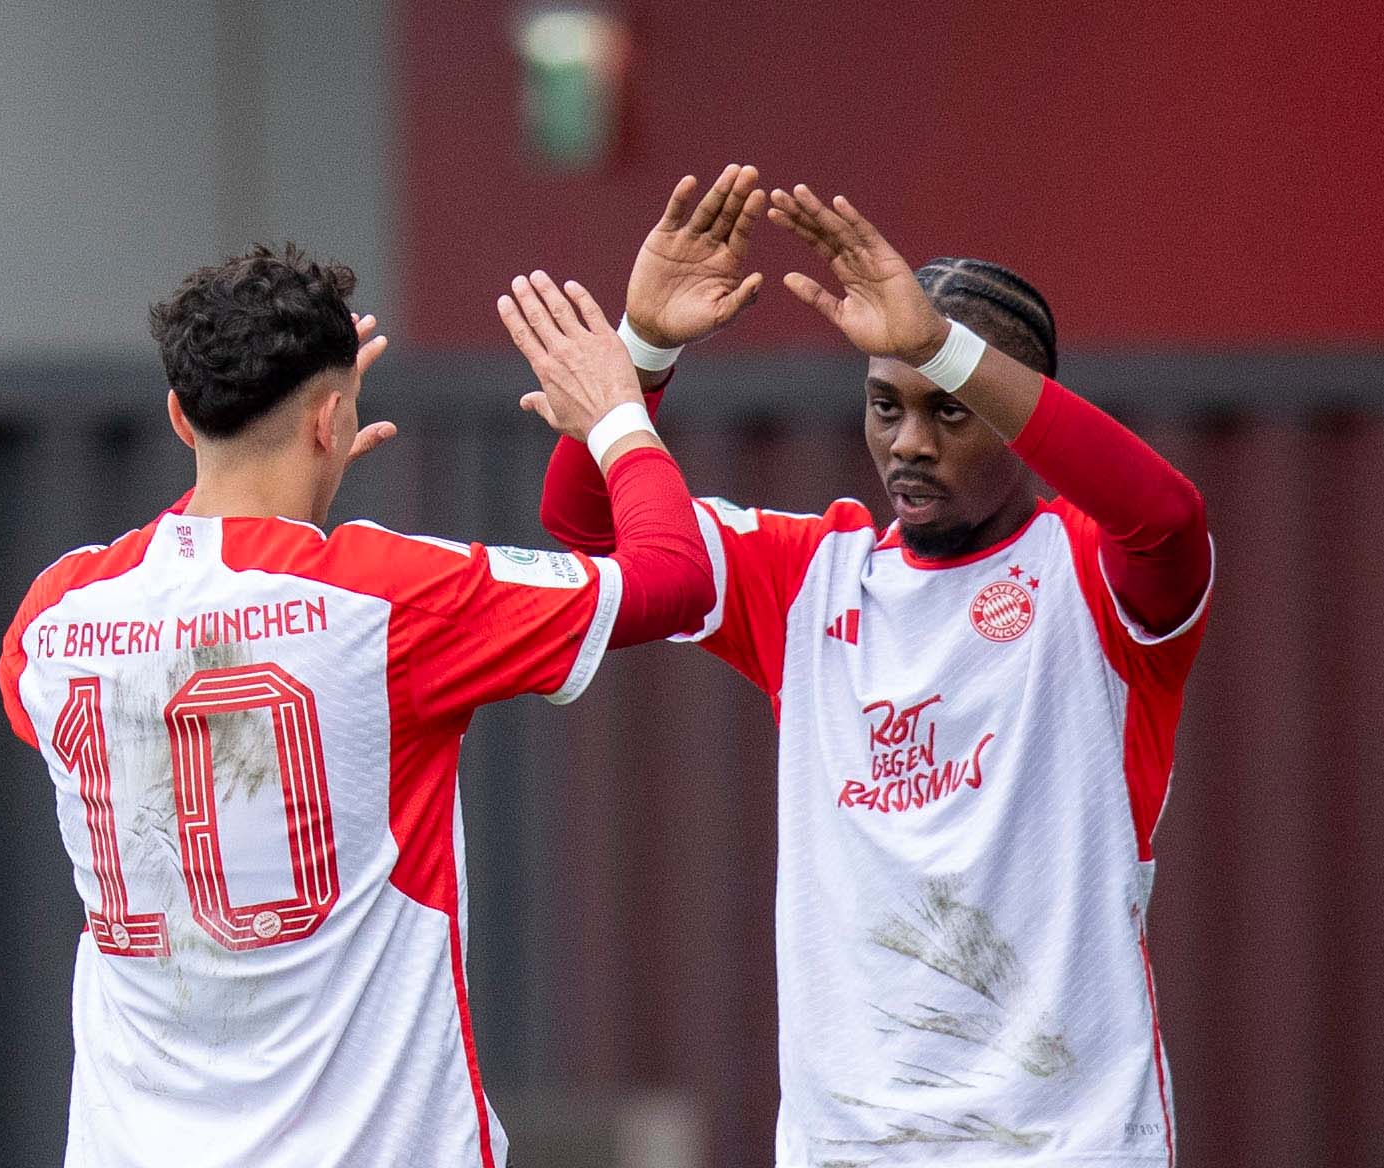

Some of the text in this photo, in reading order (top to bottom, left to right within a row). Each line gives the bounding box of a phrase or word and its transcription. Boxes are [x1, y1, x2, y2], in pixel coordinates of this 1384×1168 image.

[983, 586, 1027, 603] BAYERN
[37, 597, 328, 658] FC BAYERN MÜNCHEN
[862, 694, 943, 751] ROT
[872, 722, 936, 781] GEGEN
[838, 733, 995, 814] RASSISMUS
[51, 661, 341, 957] 10
